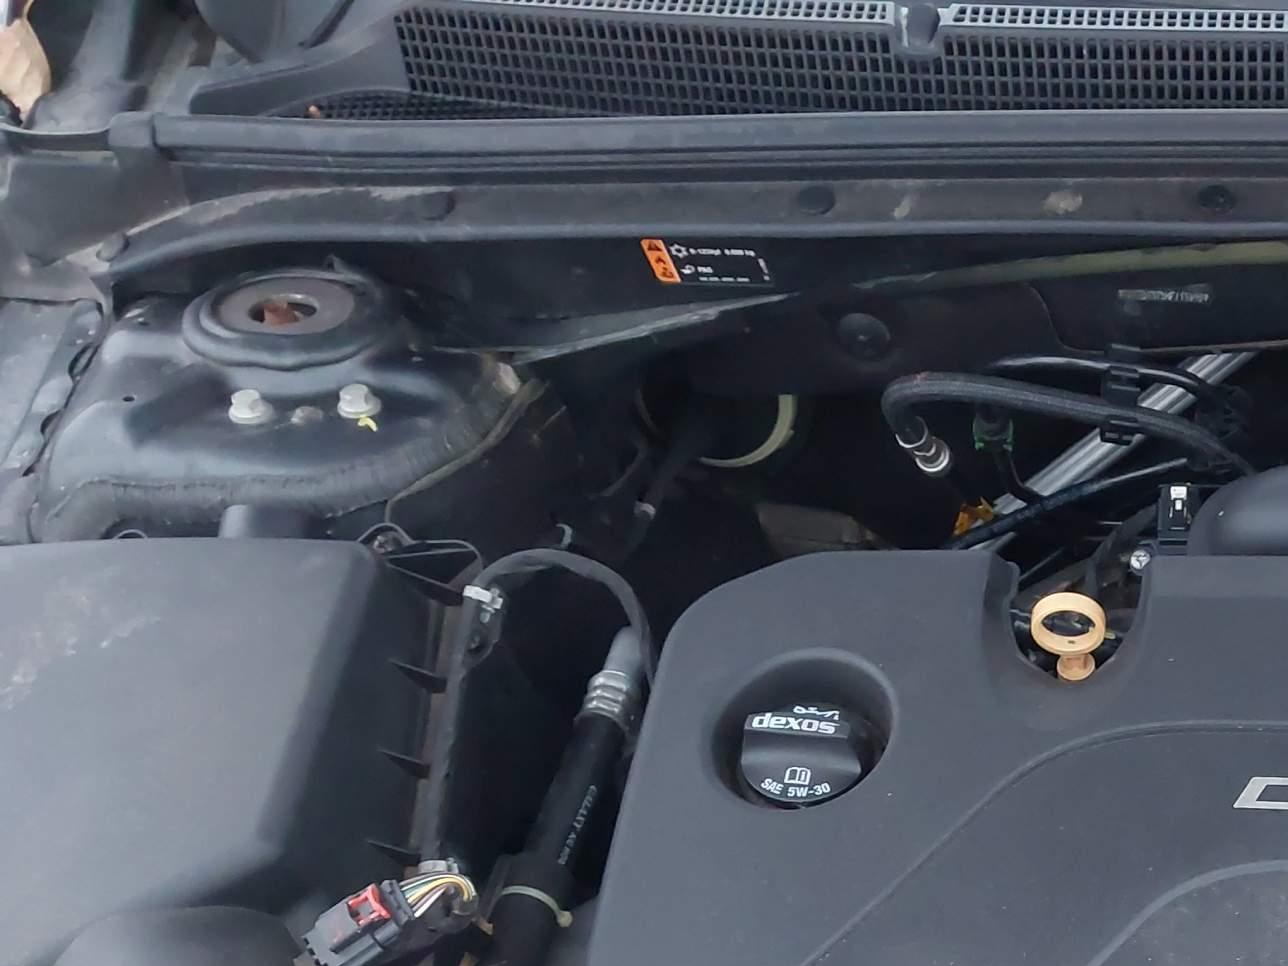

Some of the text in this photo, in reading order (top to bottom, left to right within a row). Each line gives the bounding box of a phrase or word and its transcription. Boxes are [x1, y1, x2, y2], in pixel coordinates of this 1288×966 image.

[752, 712, 840, 735] dexos
[760, 778, 831, 797] SAE 5W-30
